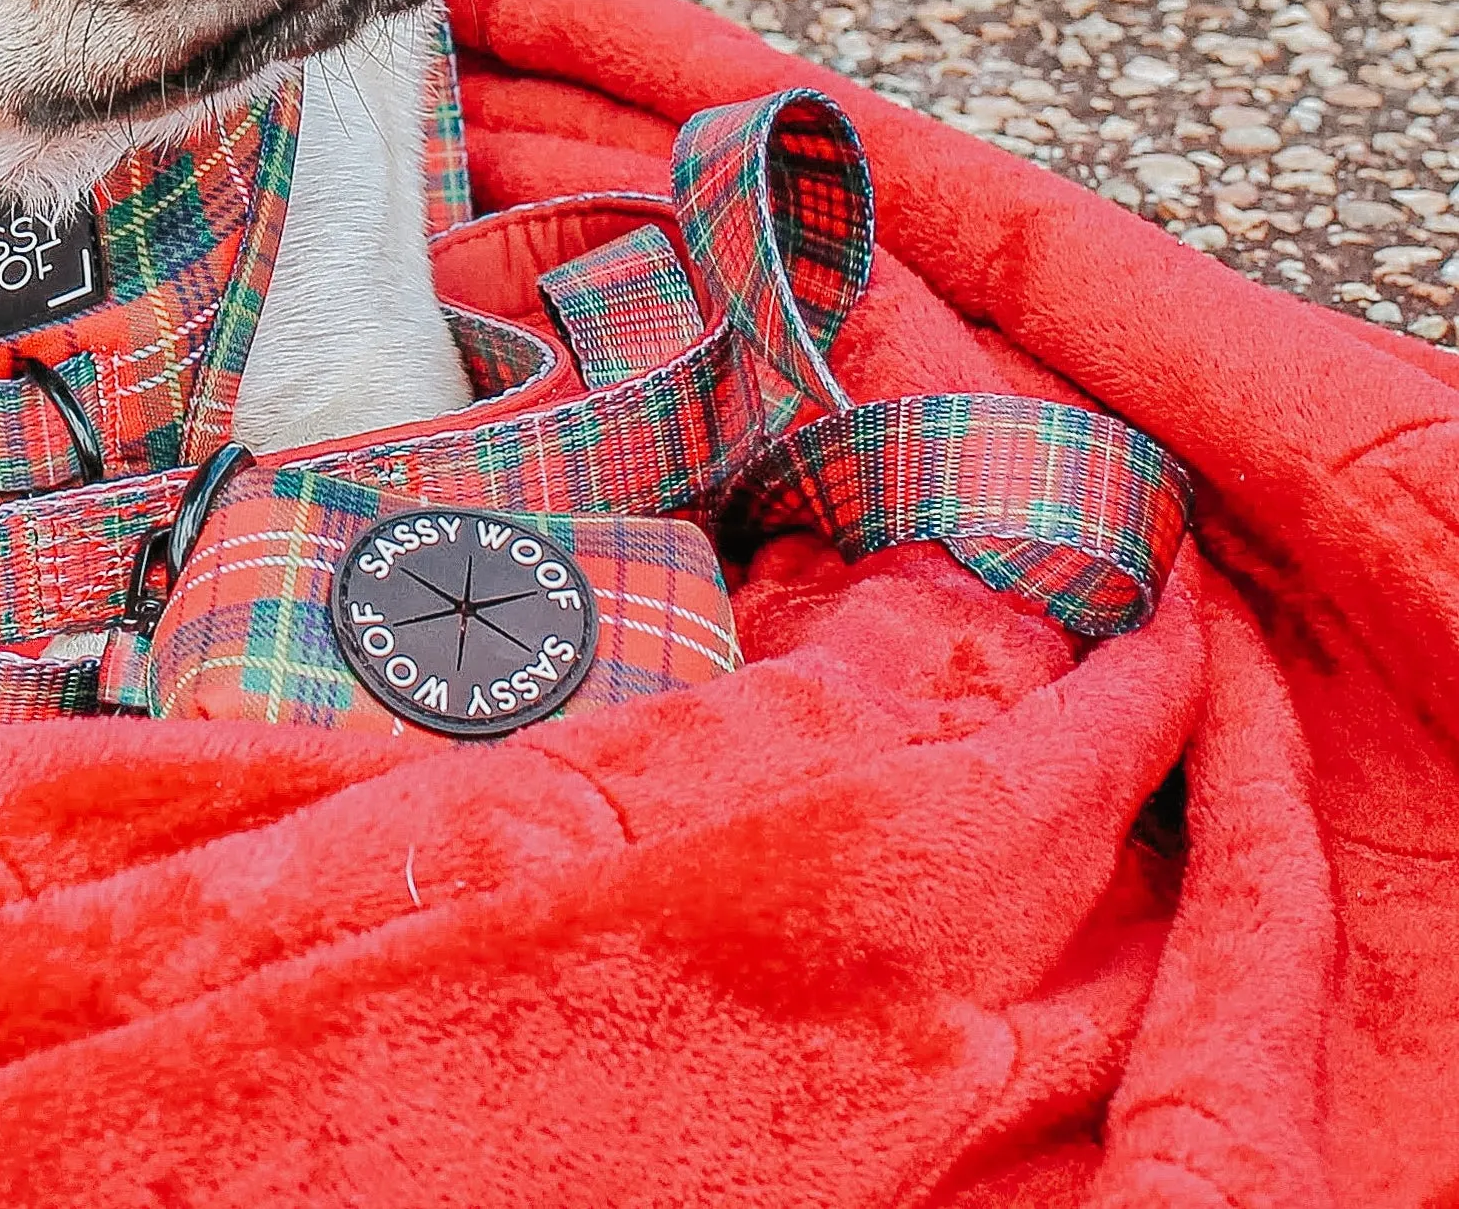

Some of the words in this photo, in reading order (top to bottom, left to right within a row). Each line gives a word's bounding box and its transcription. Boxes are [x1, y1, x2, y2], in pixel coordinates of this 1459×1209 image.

[358, 516, 461, 579] SASSY
[476, 520, 581, 610] WOOF
[350, 602, 448, 712] WOOF
[467, 635, 575, 716] SASSY
